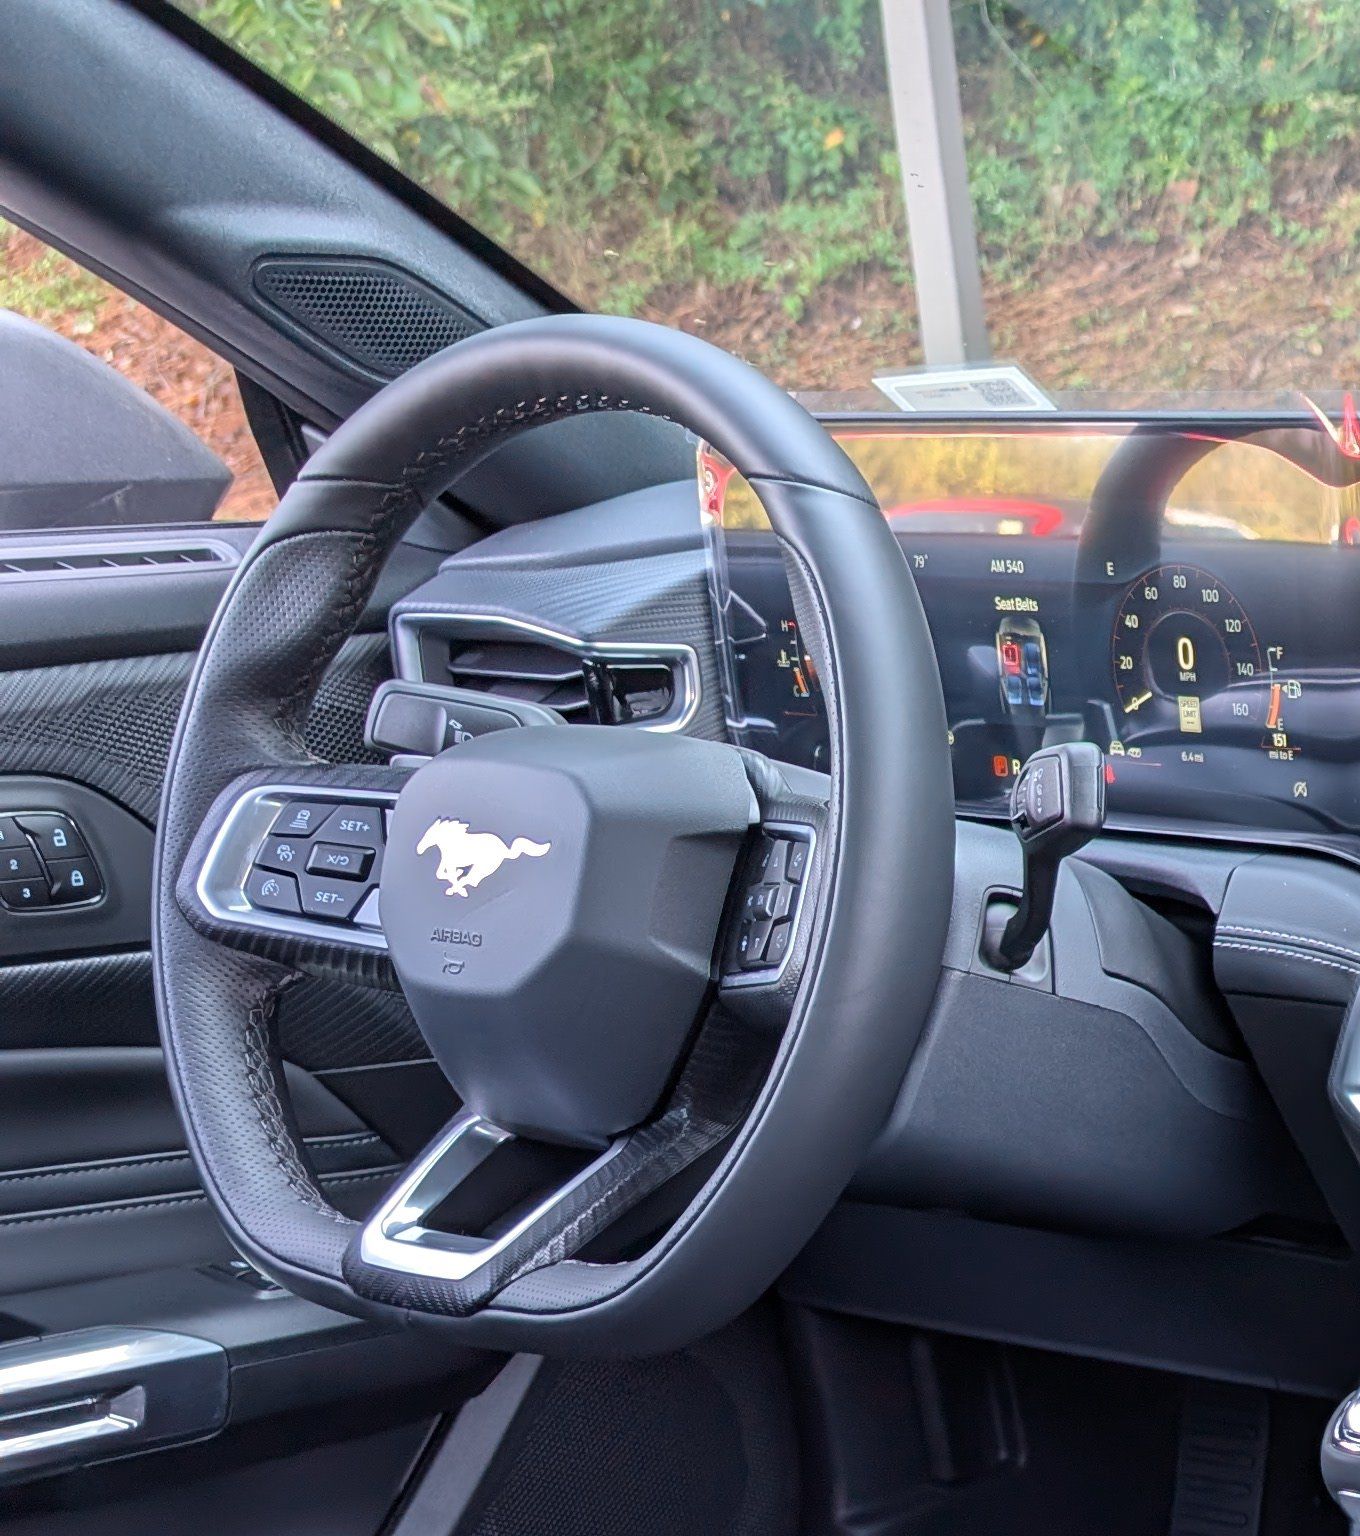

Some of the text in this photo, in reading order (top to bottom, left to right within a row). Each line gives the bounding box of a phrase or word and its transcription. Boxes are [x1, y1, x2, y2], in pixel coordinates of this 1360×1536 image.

[990, 559, 1024, 574] AM 540
[1106, 562, 1115, 576] E
[1173, 575, 1187, 590] 80
[1144, 587, 1158, 601] 60
[1202, 589, 1220, 603] 100
[994, 597, 1039, 613] Seat Belts
[1124, 615, 1139, 630] 40
[1225, 618, 1242, 633] 120
[1177, 637, 1194, 670] 0
[1276, 648, 1283, 660] F
[1120, 656, 1133, 670] 20
[1236, 662, 1254, 676] 140
[1179, 671, 1197, 683] MPH
[1231, 702, 1249, 716] 160
[1277, 718, 1284, 731] E
[1271, 733, 1288, 748] 151
[1181, 751, 1204, 763] 6.4 mi
[1269, 750, 1294, 761] mi to E
[1012, 759, 1021, 776] R
[339, 819, 370, 832] SET+
[9, 859, 19, 870] 2
[22, 887, 31, 899] 3
[430, 927, 483, 948] AIRBAG
